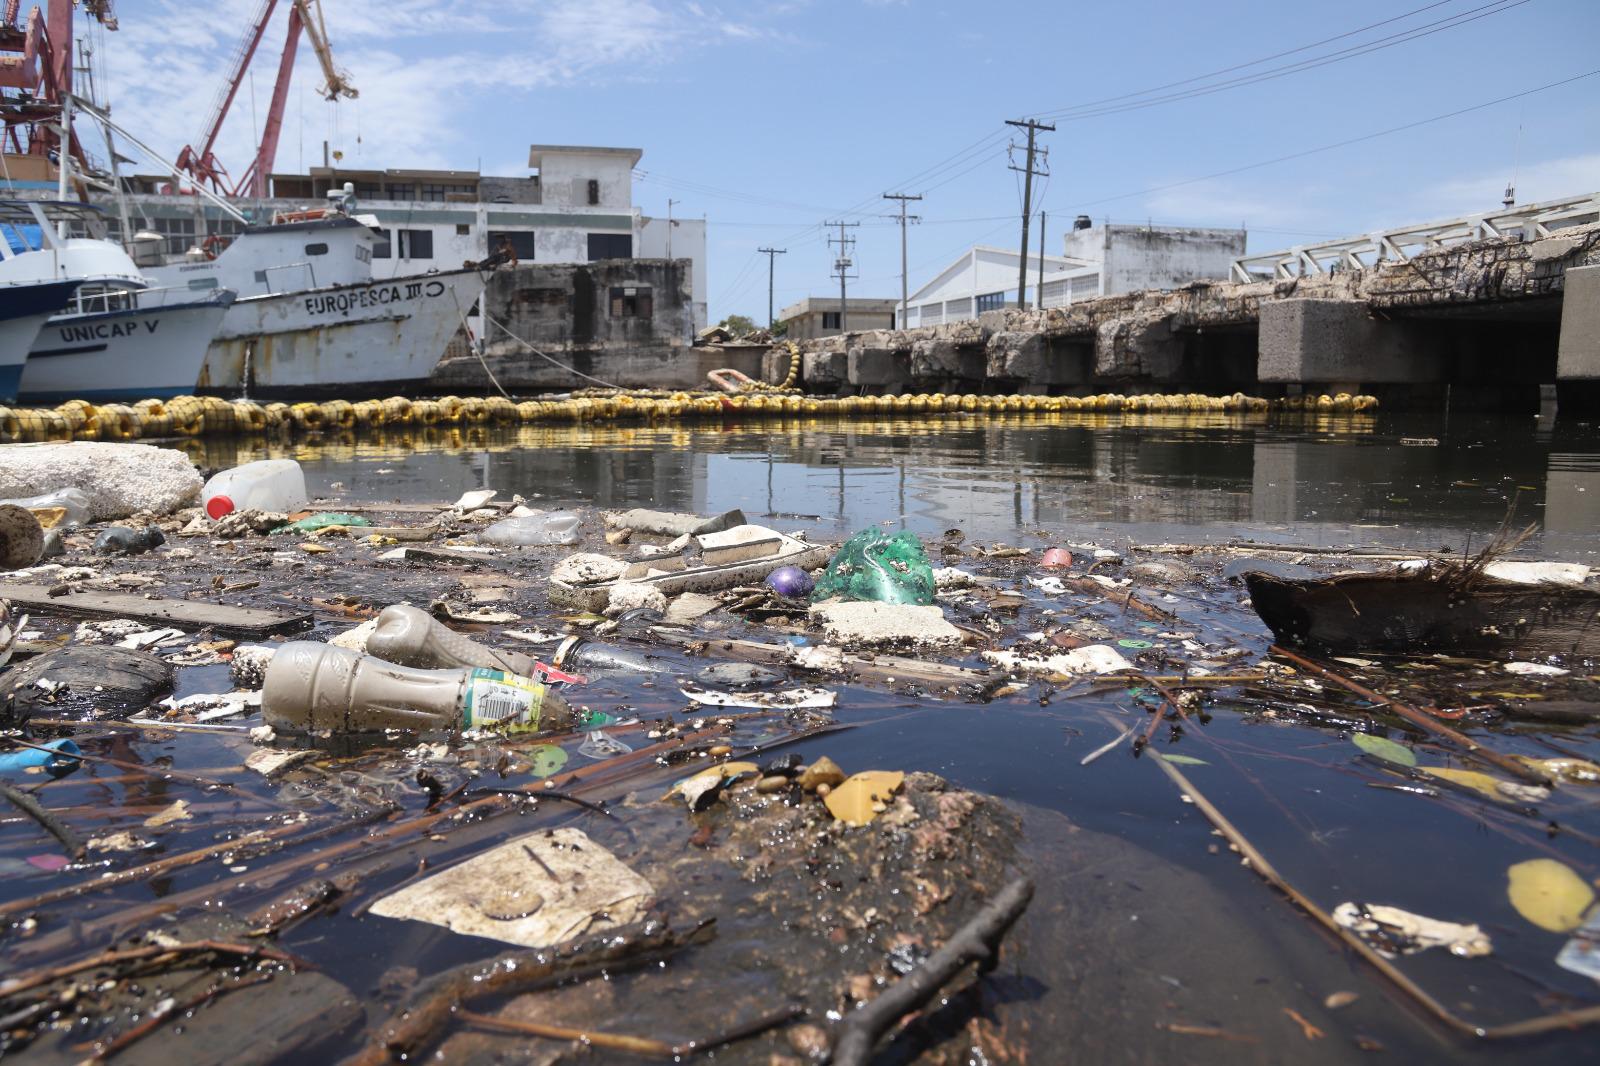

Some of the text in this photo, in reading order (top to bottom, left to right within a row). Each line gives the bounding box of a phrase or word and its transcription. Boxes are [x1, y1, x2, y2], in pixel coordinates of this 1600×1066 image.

[305, 286, 400, 315] EUROPESCA
[60, 320, 159, 342] UNICAP V
